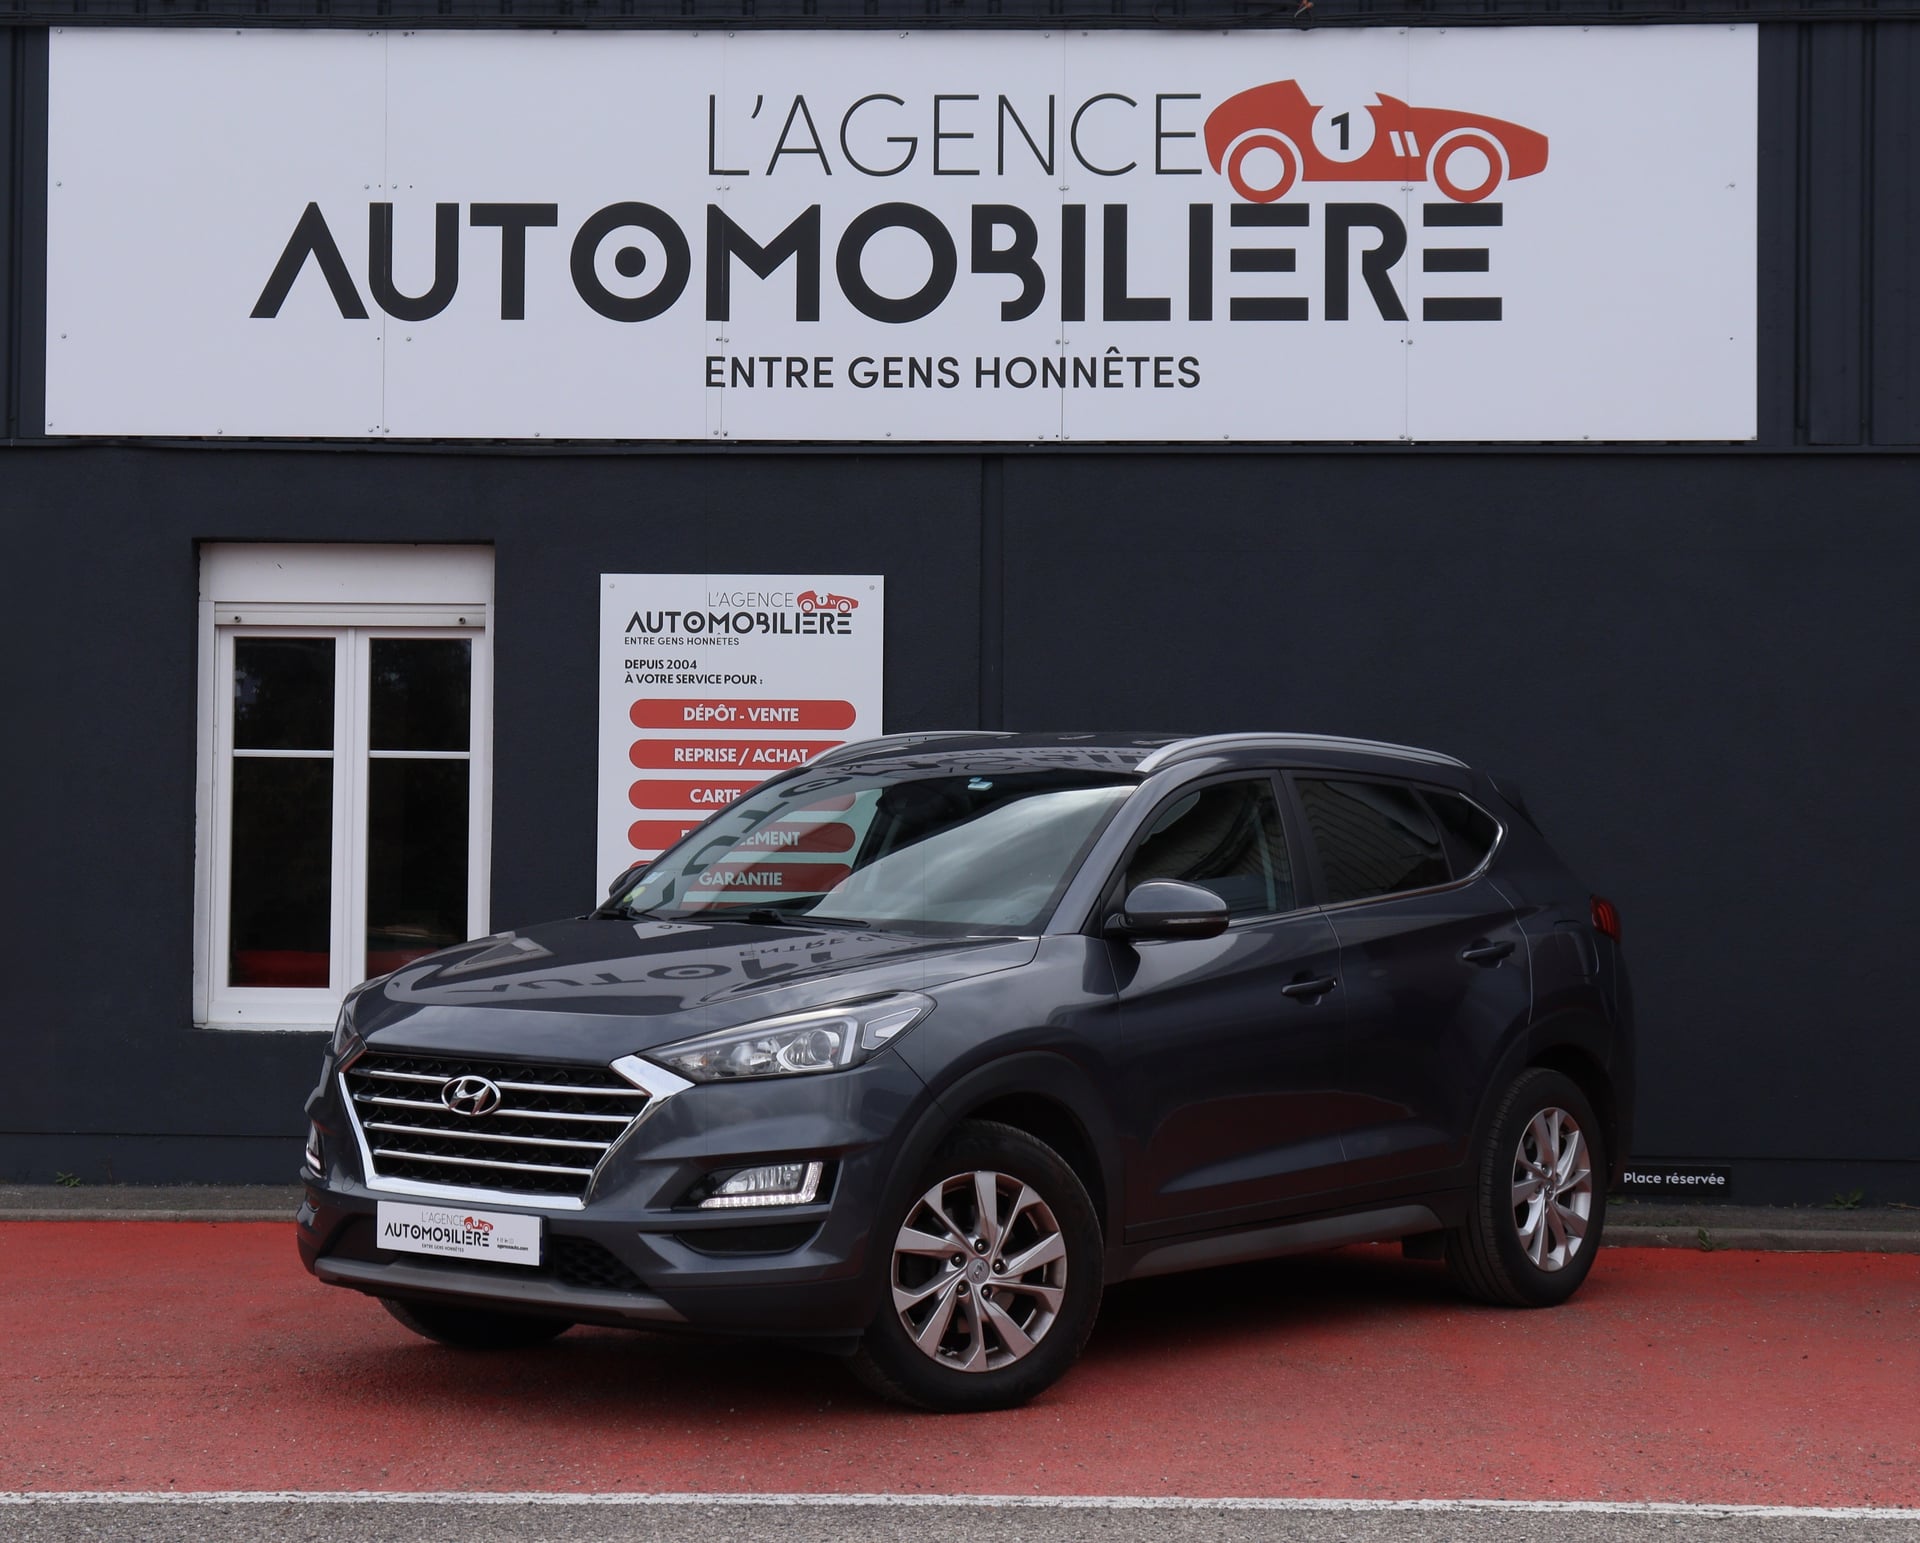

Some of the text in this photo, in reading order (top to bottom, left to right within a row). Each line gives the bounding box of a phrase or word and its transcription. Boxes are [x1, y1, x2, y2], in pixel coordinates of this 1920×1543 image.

[708, 93, 1203, 177] L'AGENCE
[1331, 112, 1350, 150] 1
[705, 345, 1201, 389] ENTRE GENS HONNÊTES
[624, 632, 740, 646] ENTRE GENS HONNÊTES
[624, 659, 698, 670] DEPUIS 2004
[624, 671, 634, 684] À
[635, 673, 674, 684] VOTRE
[675, 673, 722, 685] SERVICE
[723, 674, 758, 685] POUR
[683, 703, 737, 722] DÉPÔT
[747, 707, 800, 722] VENTE
[674, 748, 737, 763] REPRISE
[752, 748, 809, 764] ACHAT
[689, 788, 741, 804] CARTE
[698, 871, 783, 886] GARANTIE
[1623, 1172, 1726, 1185] Place réservée
